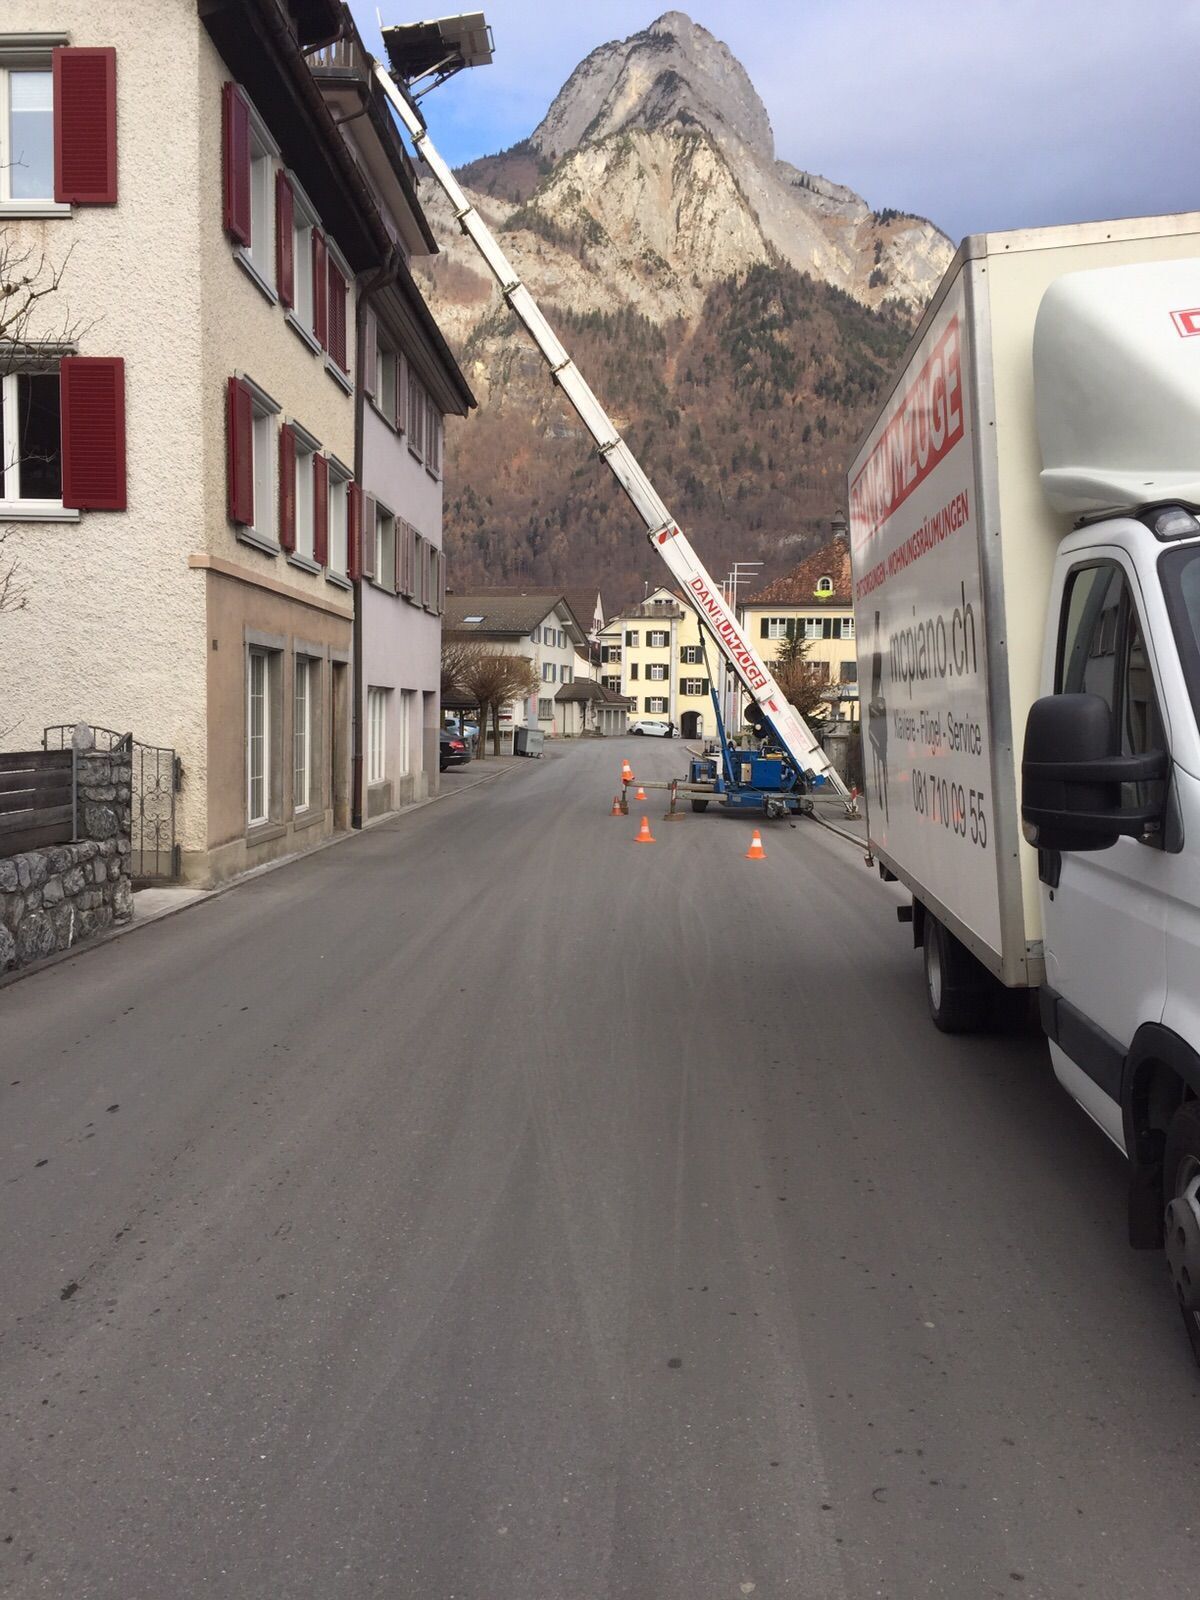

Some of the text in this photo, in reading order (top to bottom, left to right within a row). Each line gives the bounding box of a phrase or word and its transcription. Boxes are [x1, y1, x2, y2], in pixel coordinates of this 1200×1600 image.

[718, 619, 766, 689] UMZÜGE
[890, 581, 977, 700] mcpiano.ch
[920, 710, 942, 755] Flügel
[947, 711, 982, 756] Service
[912, 768, 987, 848] 081 710 09 55
